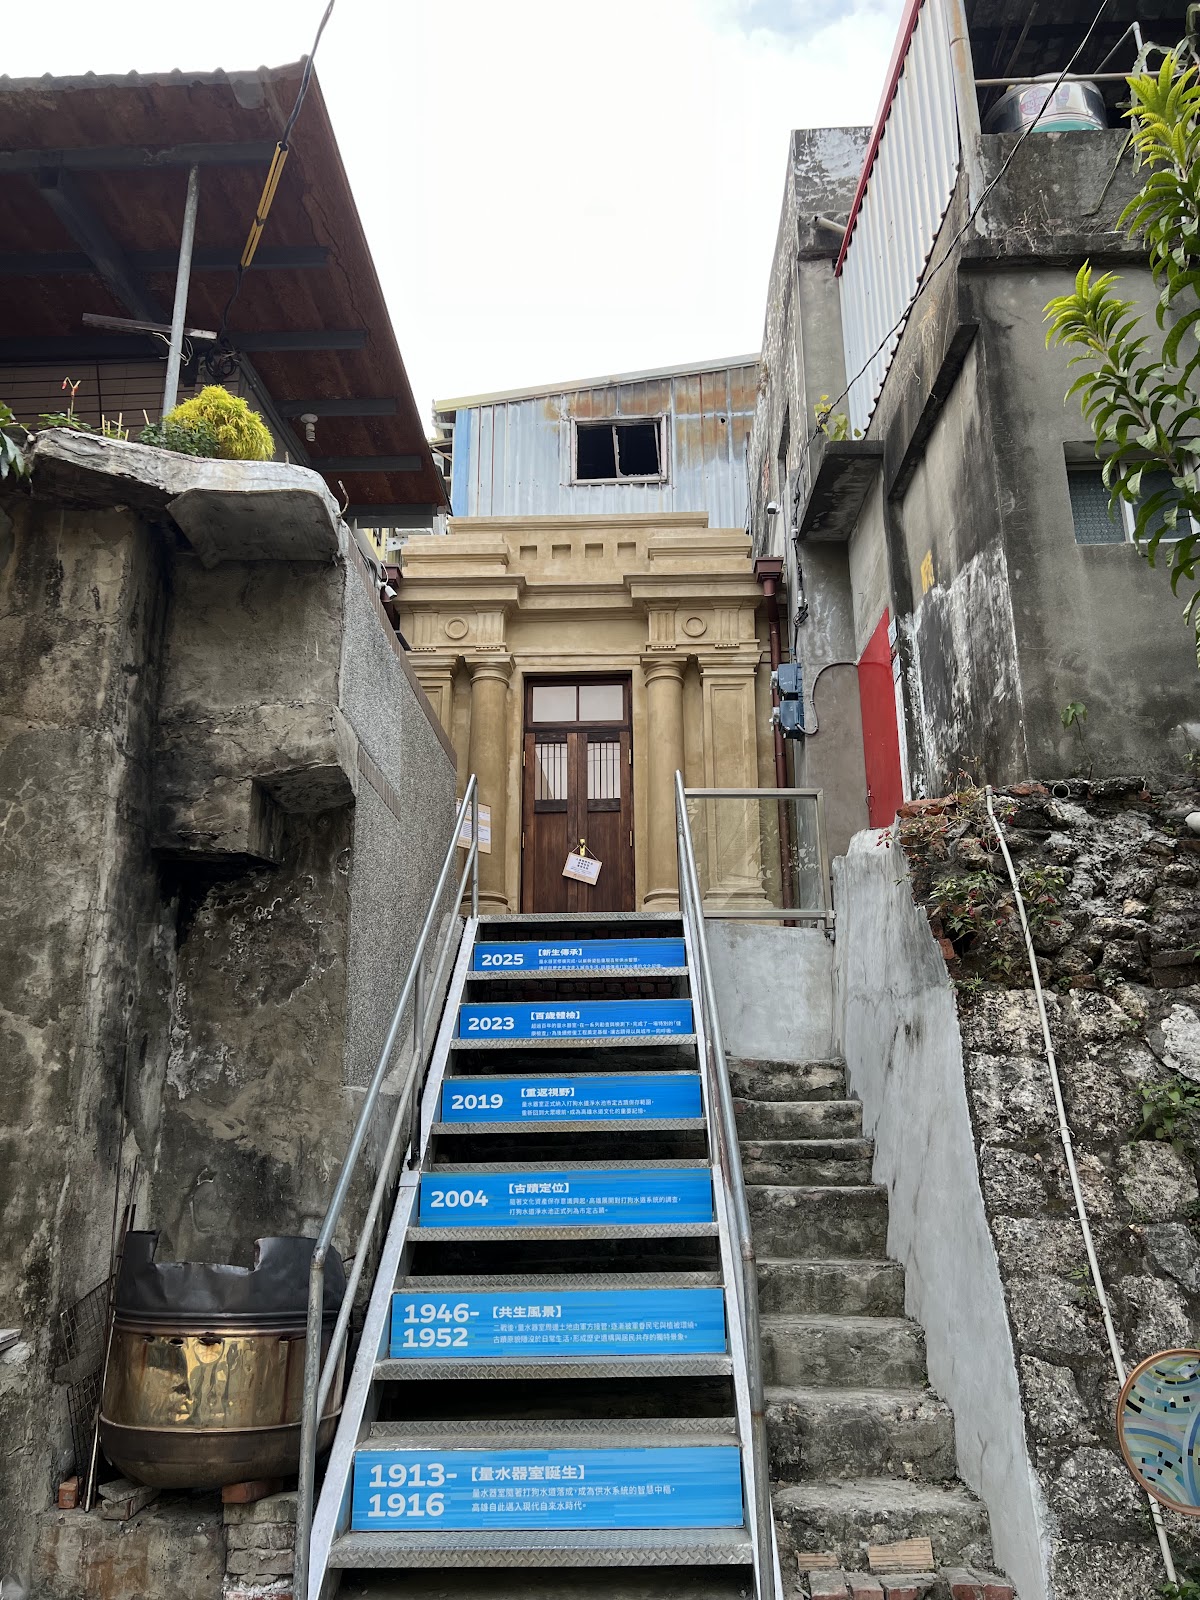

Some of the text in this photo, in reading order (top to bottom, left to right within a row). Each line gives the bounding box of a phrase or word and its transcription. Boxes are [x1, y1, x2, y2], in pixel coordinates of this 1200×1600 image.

[481, 953, 524, 966] 2025
[538, 949, 582, 957] 【新生傳承】
[530, 1011, 580, 1021] 【百歲體檢】
[468, 1016, 514, 1031] 2023
[521, 1087, 575, 1098] 【重返視野】
[451, 1093, 504, 1110] 2019
[508, 1183, 570, 1195] 【古蹟定位】
[430, 1190, 489, 1208] 2004
[403, 1302, 480, 1324] 1946-
[492, 1305, 562, 1319] 【共生風景】
[402, 1327, 469, 1348] 1952
[369, 1463, 458, 1488] 1913-
[471, 1465, 585, 1481] 【量水器室誕生】
[472, 1484, 676, 1498] 量水器室隨著打狗水道落成，成為供水系統的智慧中樞，
[367, 1492, 445, 1518] 1916
[472, 1501, 587, 1512] 高雄自此邁入現代自來水時代。
